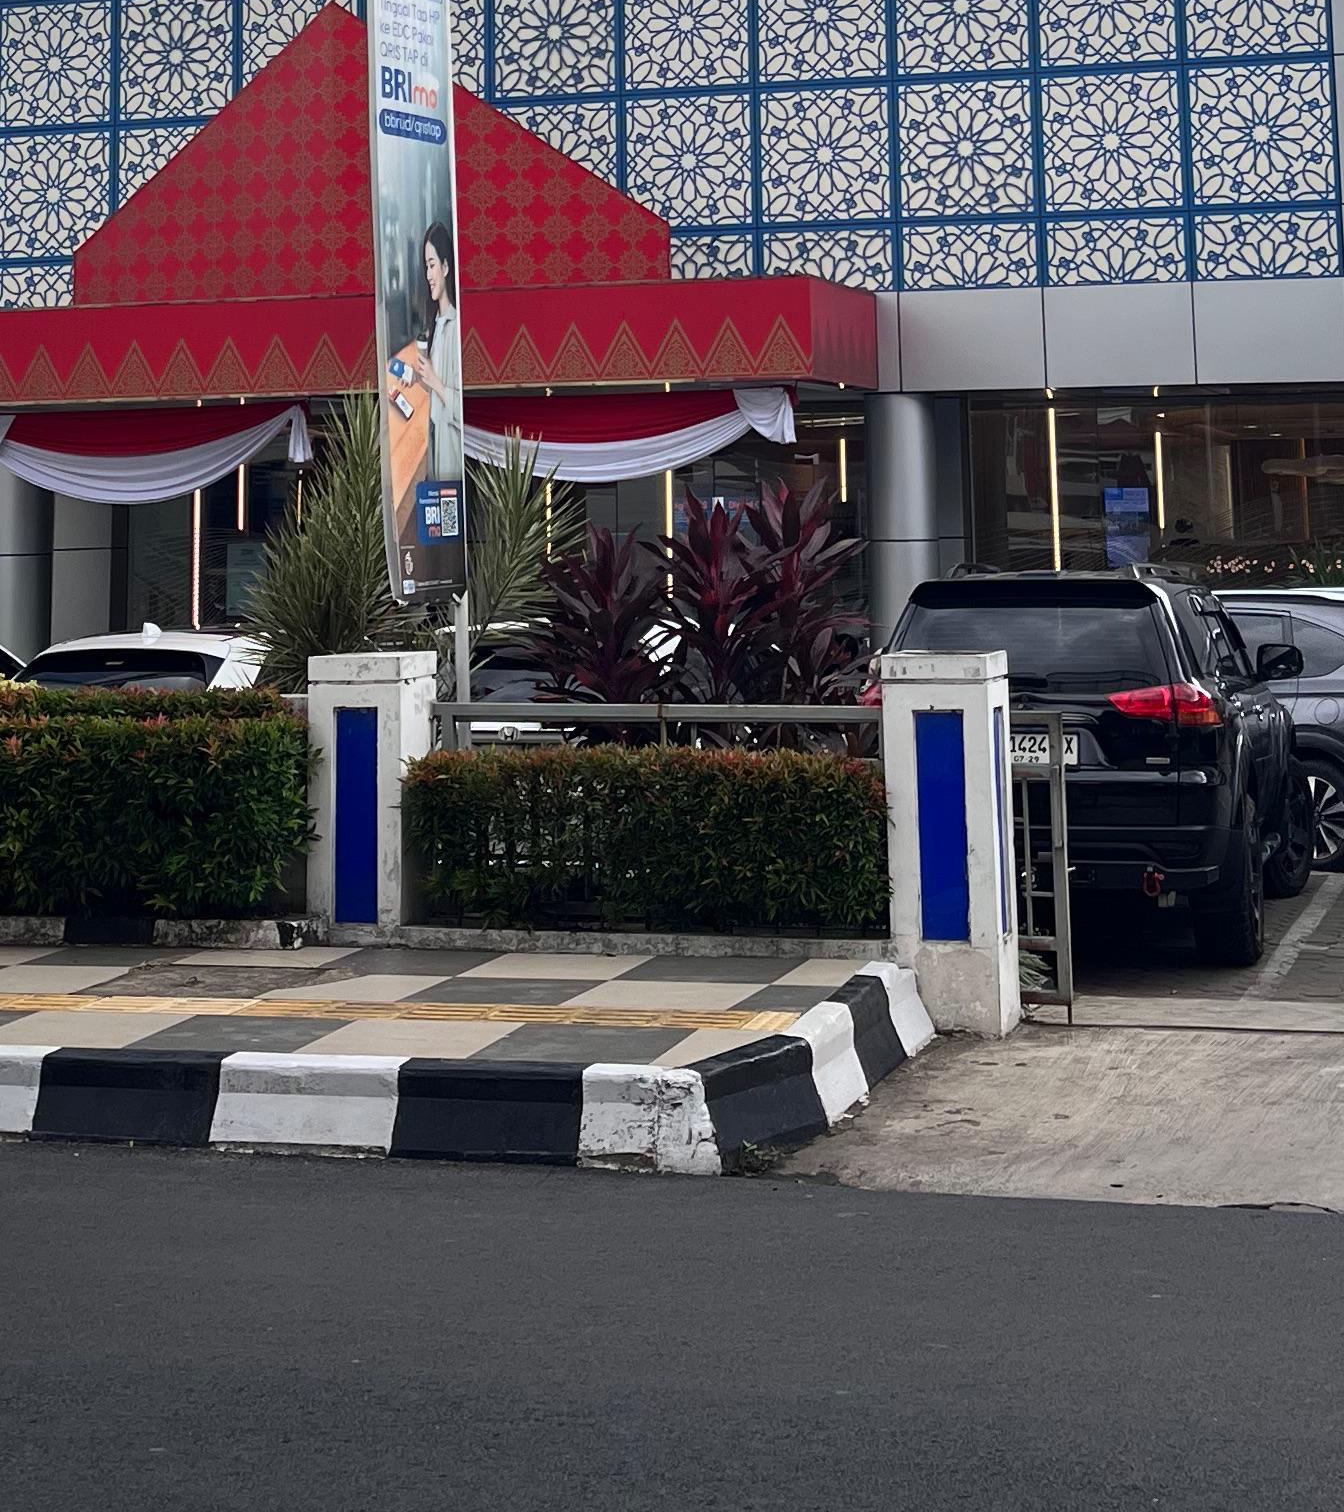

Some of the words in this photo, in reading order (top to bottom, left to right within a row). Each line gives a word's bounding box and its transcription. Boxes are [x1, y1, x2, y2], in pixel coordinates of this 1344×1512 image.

[412, 5, 427, 23] Tap
[429, 9, 440, 23] HP
[392, 22, 410, 40] EDC
[380, 41, 400, 61] QRIS
[402, 46, 418, 64] TAP
[421, 52, 429, 67] di
[425, 506, 440, 525] BRI
[1010, 736, 1047, 753] 1424
